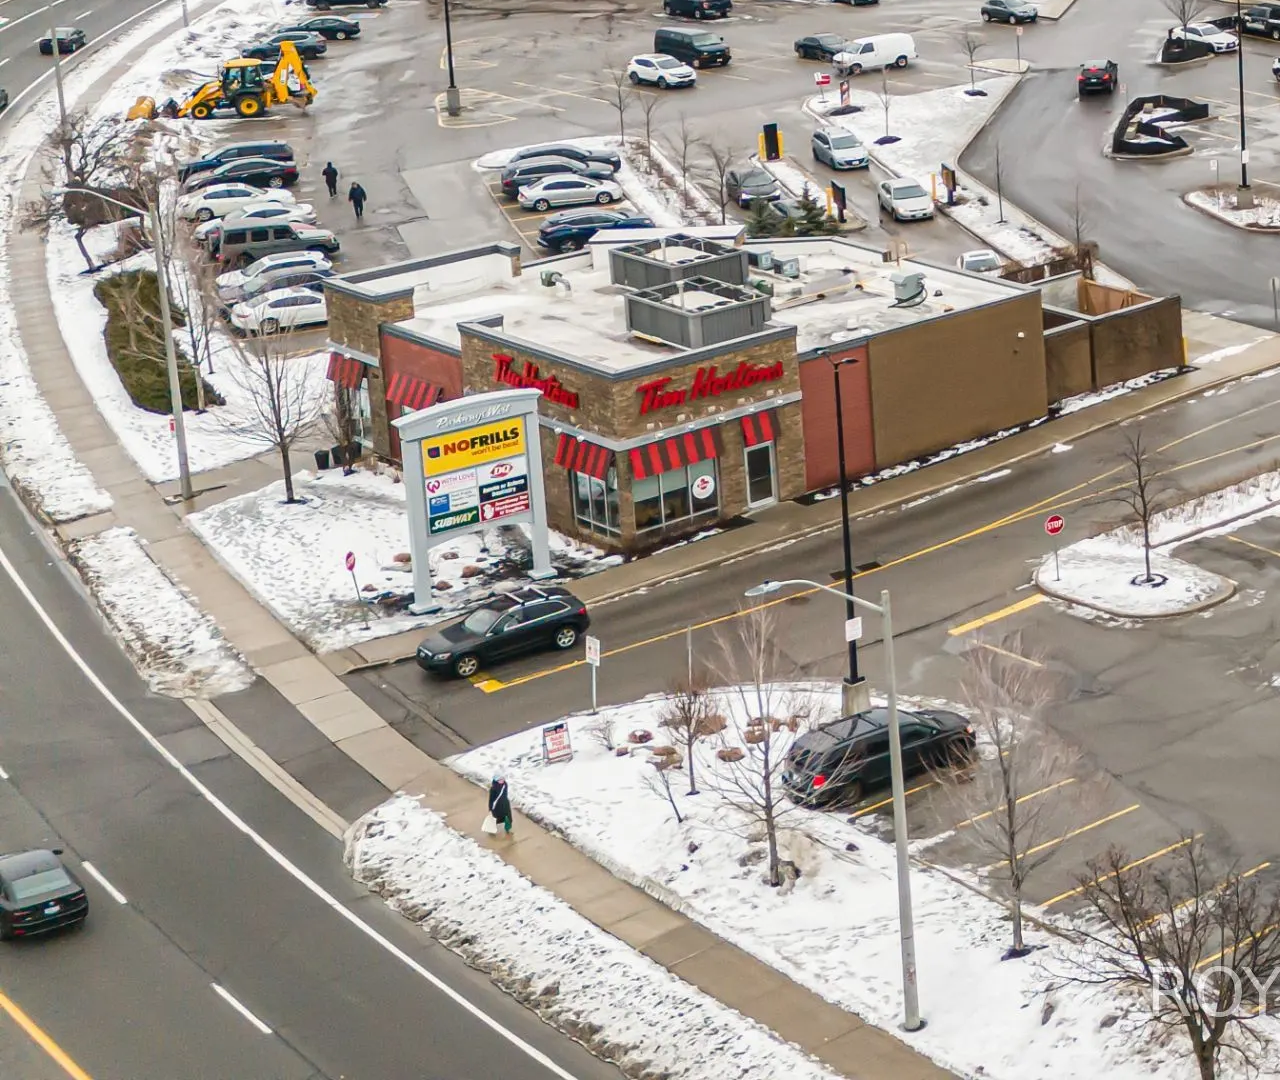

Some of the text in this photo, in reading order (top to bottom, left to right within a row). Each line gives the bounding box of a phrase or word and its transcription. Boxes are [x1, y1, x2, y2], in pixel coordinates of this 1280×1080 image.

[636, 360, 784, 415] Tim Hortons
[471, 447, 491, 456] won't
[502, 439, 519, 448] beat
[493, 464, 512, 475] DQ
[431, 511, 478, 531] SUBWAY
[1047, 519, 1063, 530] STOP
